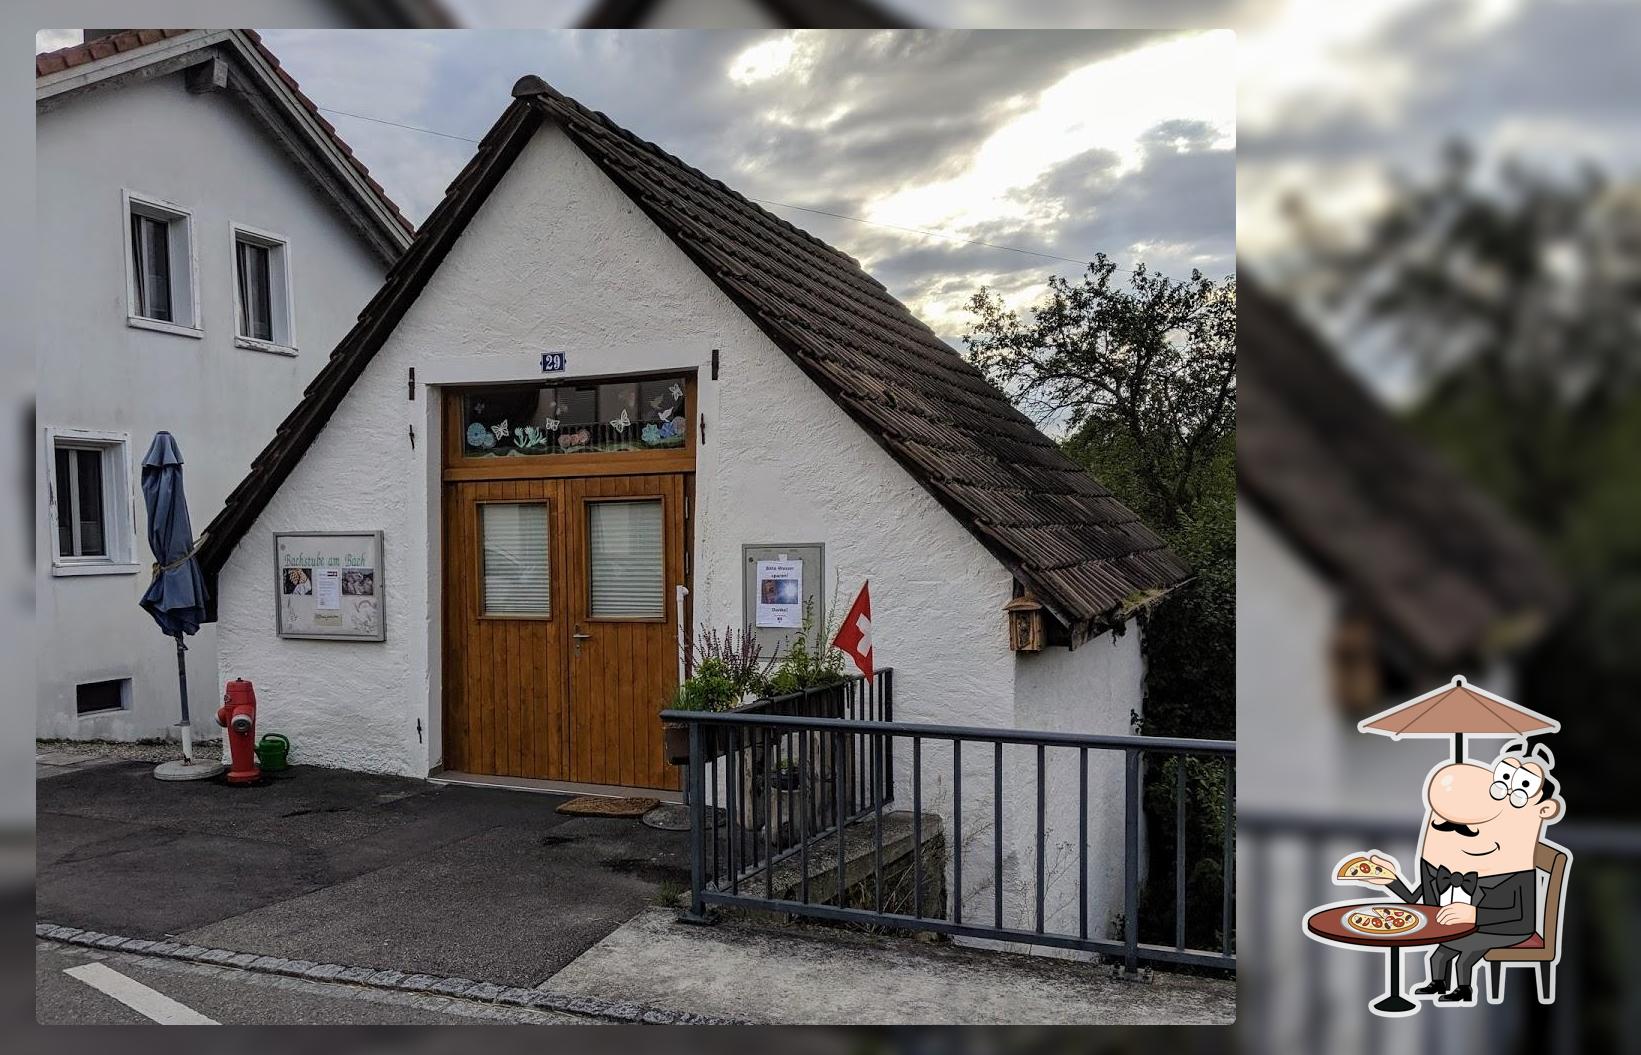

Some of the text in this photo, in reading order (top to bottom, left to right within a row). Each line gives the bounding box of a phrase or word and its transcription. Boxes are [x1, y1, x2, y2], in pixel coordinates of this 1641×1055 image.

[545, 354, 560, 370] 29
[328, 557, 340, 567] am
[345, 552, 367, 567] Bach
